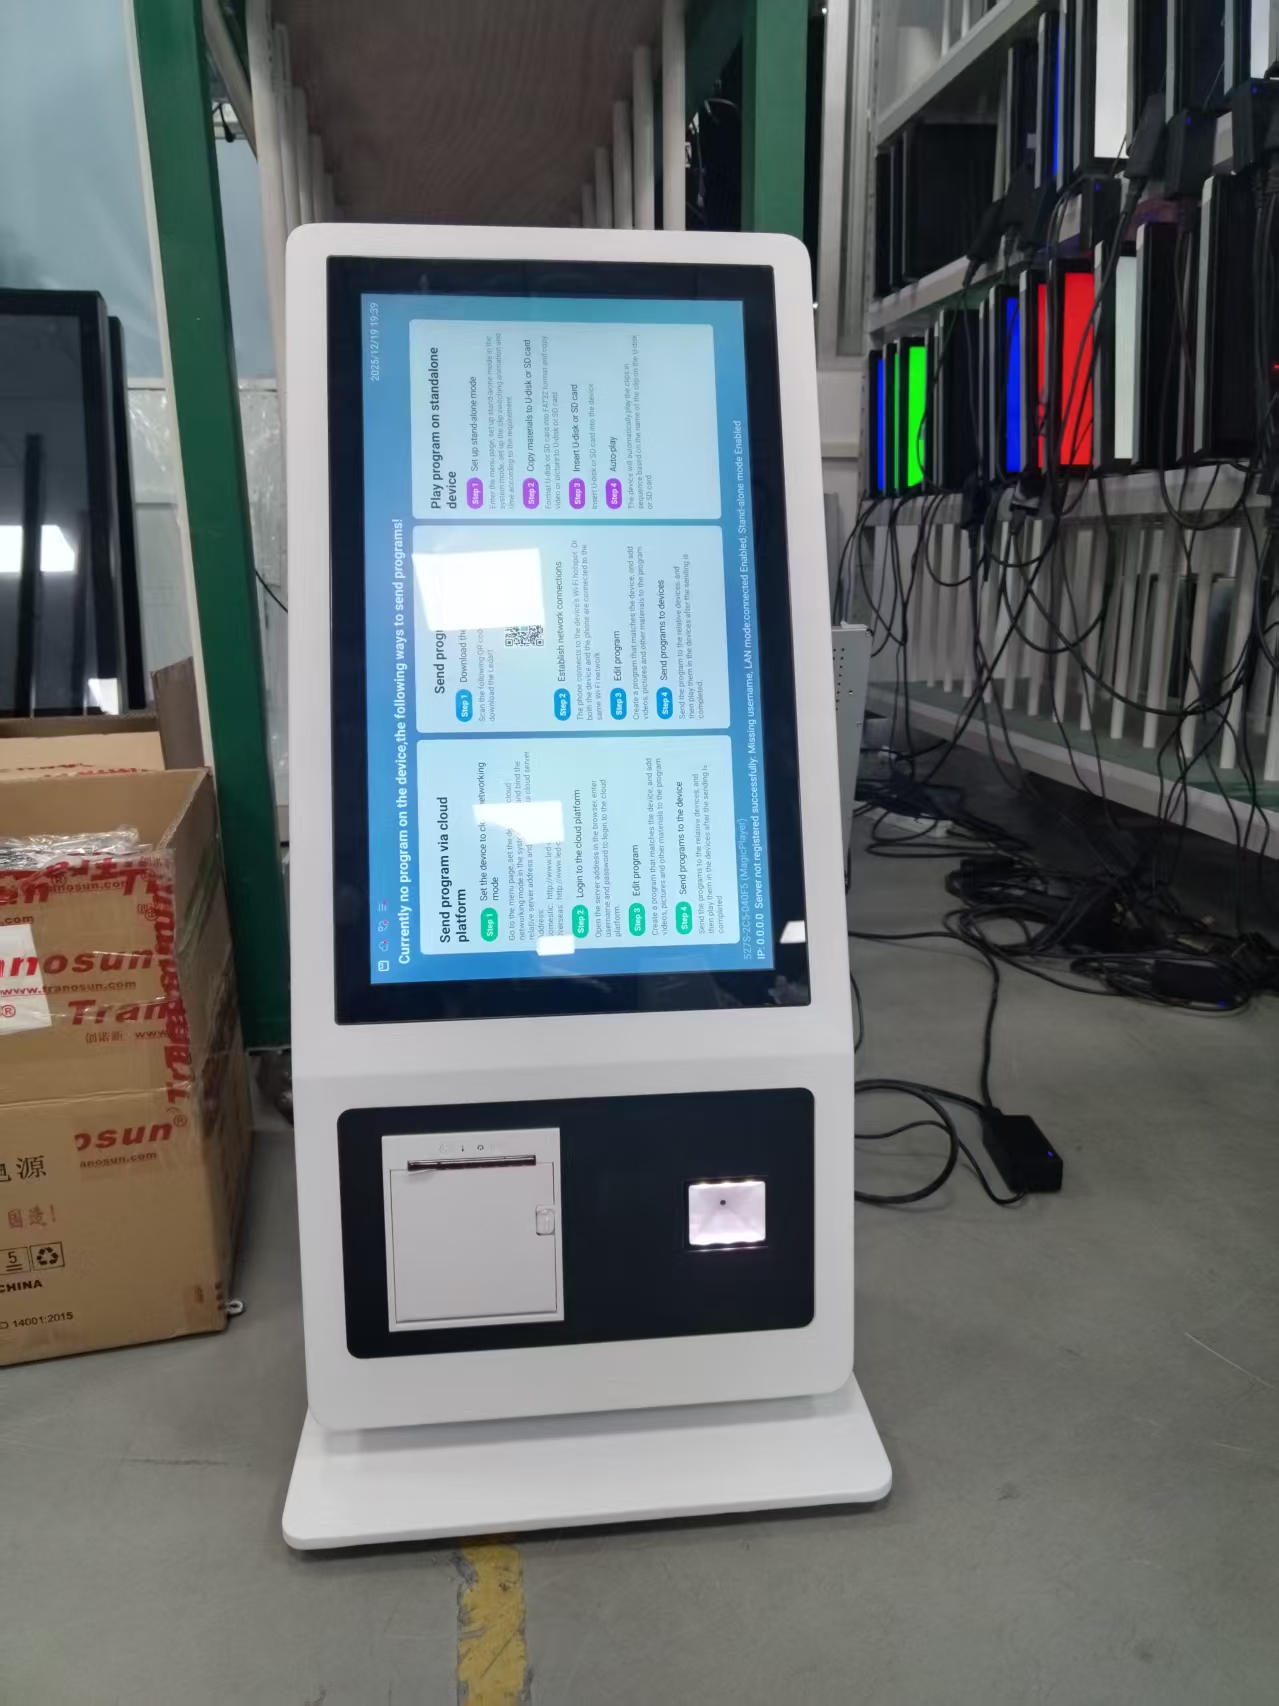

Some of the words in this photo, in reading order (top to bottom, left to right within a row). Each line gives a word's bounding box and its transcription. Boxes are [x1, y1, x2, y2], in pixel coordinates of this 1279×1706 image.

[370, 302, 378, 327] 19:39
[370, 329, 379, 381] 2025/12/19
[523, 339, 531, 356] card
[524, 358, 531, 369] SD
[526, 370, 532, 379] or
[427, 347, 439, 411] standalone
[469, 377, 477, 399] mode
[524, 380, 532, 404] U-disk
[570, 384, 578, 401] card
[526, 405, 533, 413] to
[571, 402, 578, 413] SD
[573, 415, 579, 423] or
[431, 414, 440, 428] on
[469, 400, 478, 445] stand-alone
[525, 415, 534, 451] materials
[571, 425, 579, 448] U-disk
[733, 420, 743, 454] Enabled
[432, 431, 443, 481] program
[472, 447, 480, 457] up
[527, 452, 536, 472] Copy
[572, 450, 580, 472] Insert
[608, 436, 619, 472] Auto-play
[735, 456, 744, 481] mode
[430, 484, 444, 509] Play
[445, 471, 456, 509] device
[472, 489, 480, 505] Step
[528, 489, 536, 505] Step
[574, 489, 582, 505] Step
[610, 489, 619, 505] Step
[736, 483, 746, 534] Stand-alone
[391, 518, 406, 579] programs!
[738, 536, 749, 572] Enabled,
[391, 582, 404, 611] send
[555, 561, 563, 609] connections
[628, 575, 636, 599] device,
[656, 580, 665, 609] devices
[393, 614, 404, 626] to
[659, 611, 665, 619] to
[740, 574, 752, 647] mode:connected
[556, 611, 564, 643] network
[629, 613, 637, 643] matches
[395, 629, 408, 660] ways
[614, 630, 622, 664] program
[660, 621, 669, 659] programs
[459, 643, 467, 683] Download
[557, 645, 565, 682] Establish
[660, 660, 668, 681] Send
[744, 649, 753, 668] LAN
[433, 663, 445, 694] Send
[613, 666, 621, 681] Edit
[632, 659, 640, 689] program
[392, 663, 409, 719] following
[747, 670, 756, 716] username,
[460, 701, 469, 717] Step
[559, 699, 568, 716] Step
[615, 699, 624, 715] Step
[661, 698, 670, 715] Step
[747, 718, 758, 753] Missing
[393, 722, 409, 785] device,the
[675, 781, 683, 807] device
[748, 755, 761, 813] successfully:
[394, 788, 407, 808] the
[573, 789, 583, 824] platform
[398, 811, 407, 827] on
[436, 796, 448, 831] cloud
[676, 809, 684, 822] the
[479, 834, 486, 842] to
[574, 826, 582, 848] cloud
[601, 822, 609, 840] login
[677, 823, 684, 832] to
[751, 815, 763, 861] registered
[437, 834, 449, 852] via
[679, 834, 688, 873] programs
[398, 830, 411, 883] program
[479, 844, 487, 871] device
[574, 850, 582, 863] the
[602, 850, 611, 885] password
[633, 844, 641, 879] program
[440, 855, 453, 908] program
[479, 872, 487, 886] the
[576, 865, 583, 874] to
[754, 863, 762, 878] not
[399, 886, 409, 902] no
[491, 877, 499, 901] mode
[575, 875, 585, 898] Login
[632, 881, 640, 896] Edit
[678, 874, 687, 895] Send
[754, 880, 764, 909] Server
[439, 911, 451, 943] Send
[454, 889, 469, 943] platform
[486, 919, 495, 937] Step
[577, 916, 586, 934] Step
[633, 914, 642, 932] Step
[680, 913, 689, 930] Step
[396, 905, 413, 965] Currently
[756, 913, 765, 945] 0.0.0.0
[0, 951, 154, 977] nosun
[754, 947, 766, 960] IP:
[13, 1312, 73, 1328] 14001:2015
